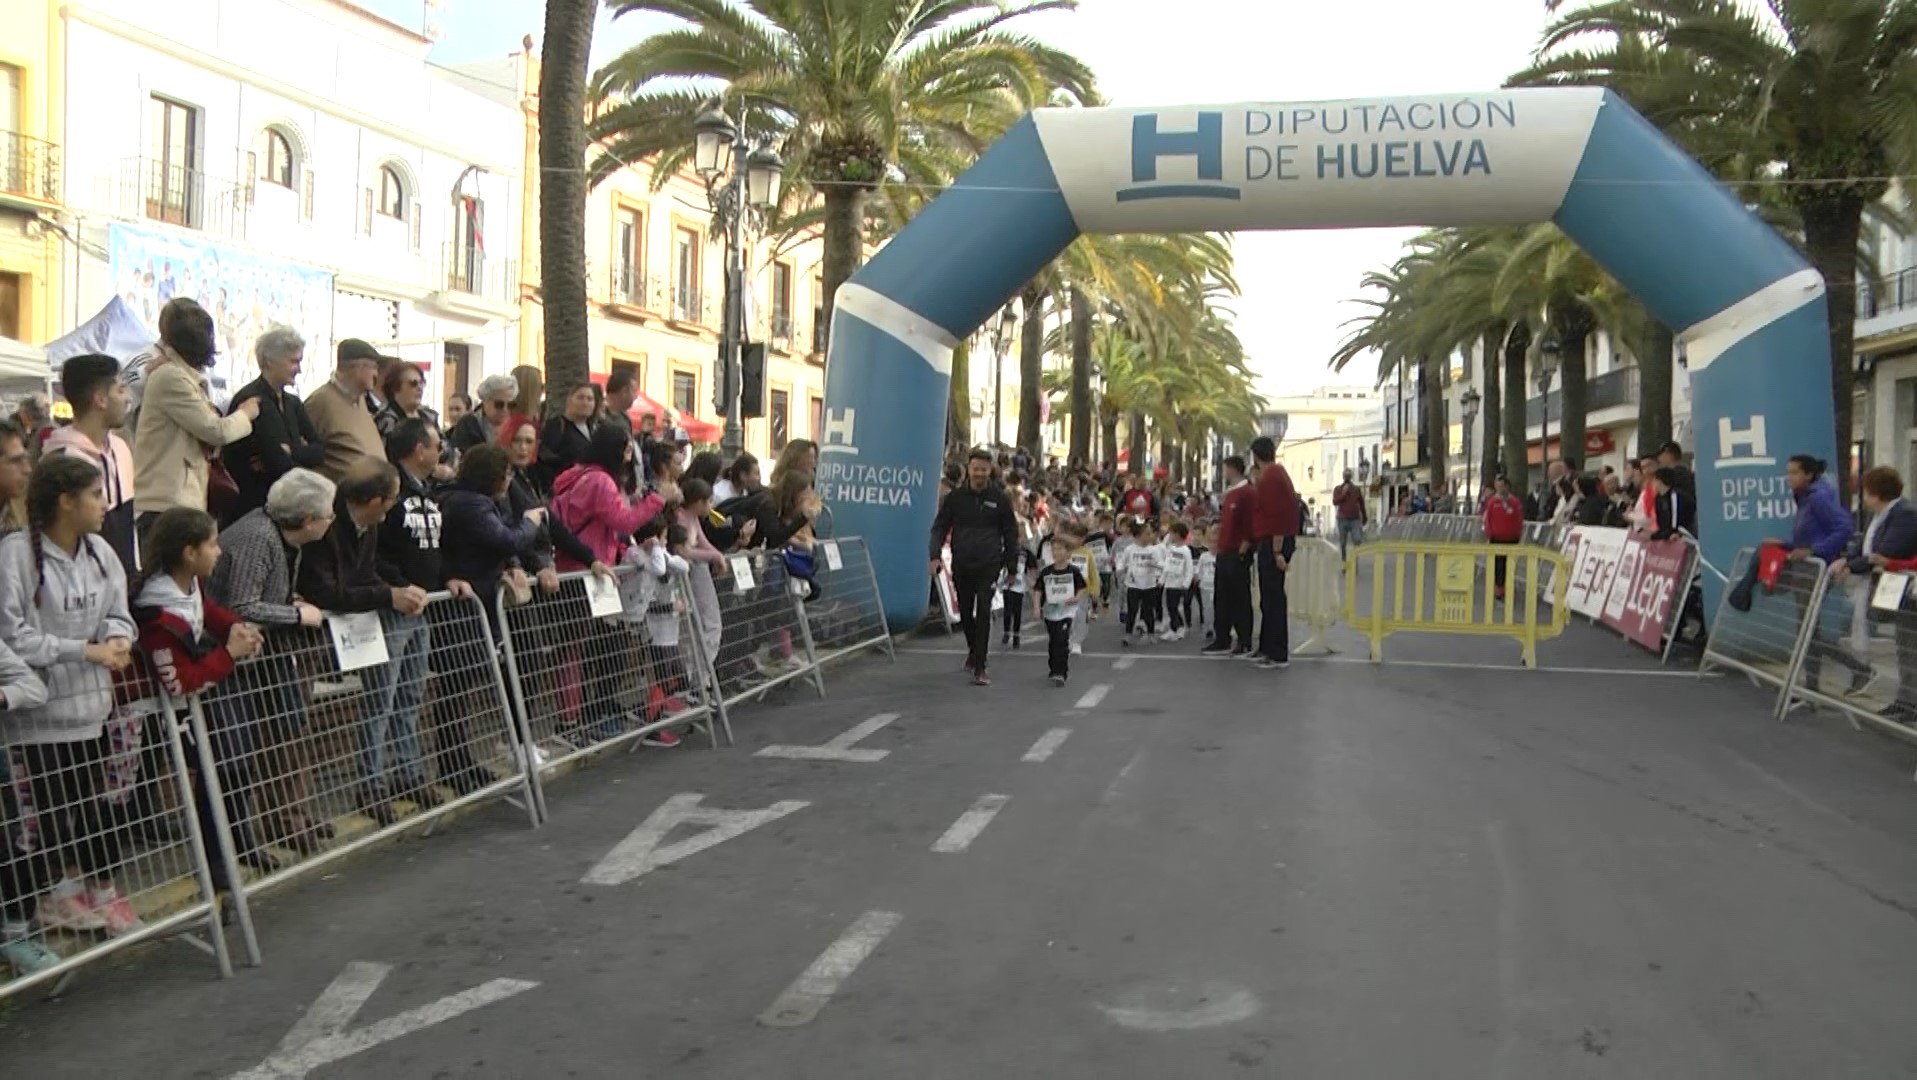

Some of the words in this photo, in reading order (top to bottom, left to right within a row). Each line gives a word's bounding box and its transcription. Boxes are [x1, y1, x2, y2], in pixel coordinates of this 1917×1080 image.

[1246, 97, 1516, 136] DIPUTACIÓN
[1246, 145, 1299, 181] DE
[1317, 139, 1491, 179] HUELVA
[817, 463, 923, 486] DIPUTACIÓN
[838, 485, 912, 507] HUELVA
[1721, 476, 1793, 498] DIPUT
[1723, 501, 1750, 520] DE
